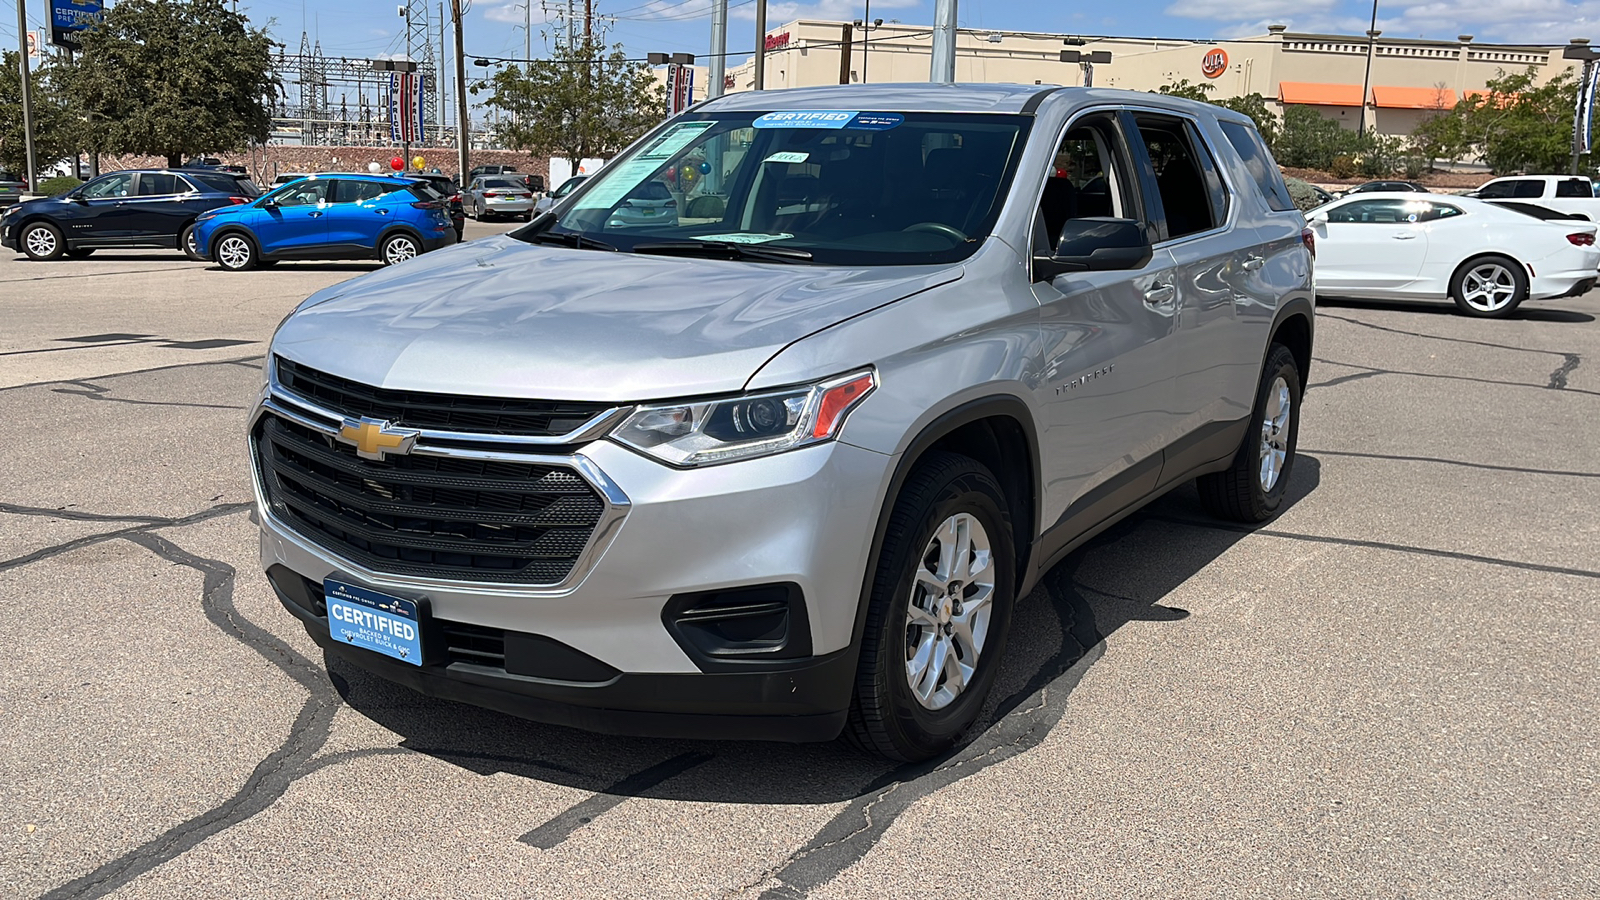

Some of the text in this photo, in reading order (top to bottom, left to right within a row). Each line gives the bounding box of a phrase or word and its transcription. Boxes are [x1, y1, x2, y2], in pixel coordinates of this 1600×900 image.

[392, 101, 401, 140] PRICES
[762, 113, 849, 121] CERTIFIED
[1055, 363, 1115, 396] TRAVERSE
[332, 590, 352, 599] CERTIFIED
[332, 604, 415, 641] CERTIFIED
[359, 628, 382, 639] BACKED
[340, 628, 374, 642] CHEVROLET
[375, 637, 392, 648] BUICK
[398, 645, 411, 654] GMC
